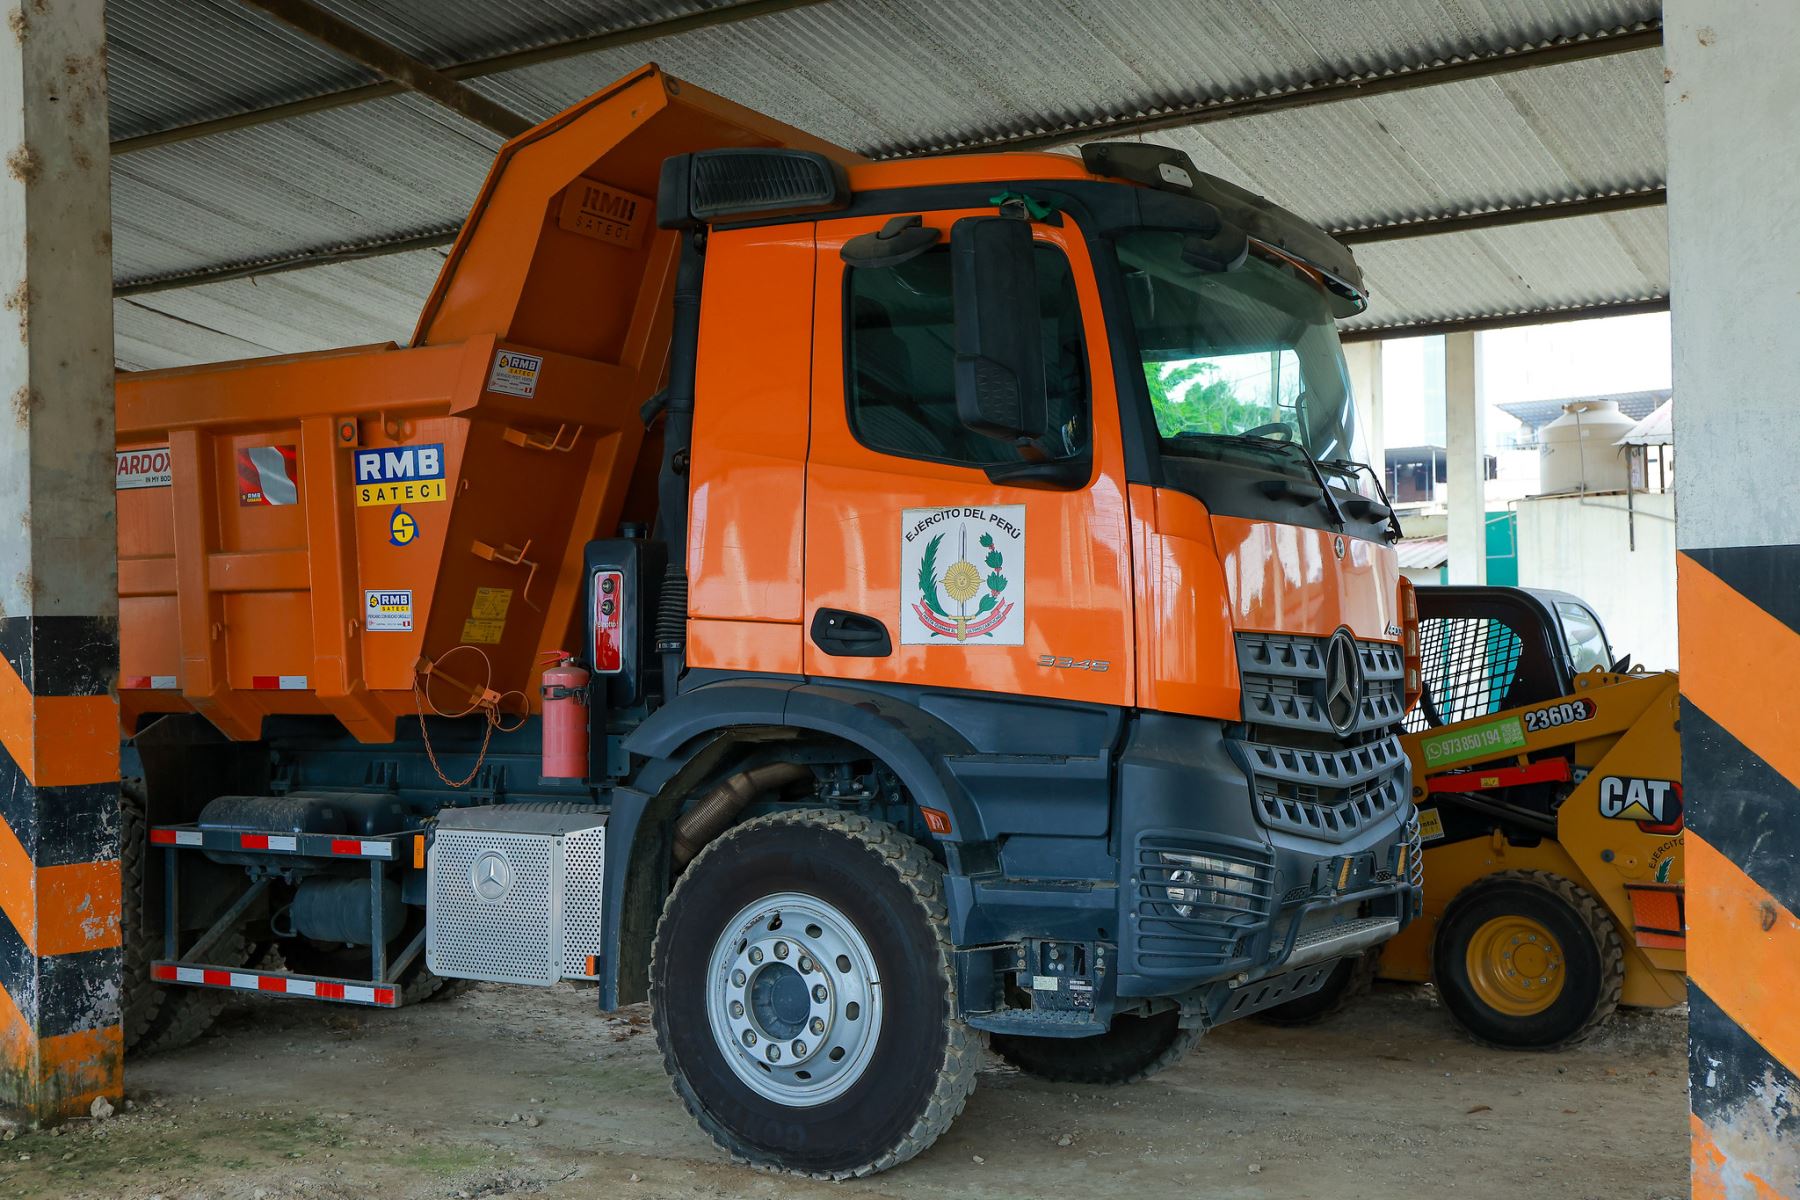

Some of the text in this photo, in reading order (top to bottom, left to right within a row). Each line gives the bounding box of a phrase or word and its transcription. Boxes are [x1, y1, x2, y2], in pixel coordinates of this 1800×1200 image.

[576, 215, 629, 240] SATECI
[511, 358, 536, 370] RMB
[115, 453, 171, 475] ARDOX
[359, 448, 439, 480] RMB
[362, 484, 441, 502] SATECI
[905, 508, 1021, 543] EJÉRCITO DEL PERÚ
[381, 595, 408, 605] RMB
[1037, 655, 1112, 672] 3345
[1525, 700, 1586, 732] 236D3
[1442, 729, 1501, 755] 973 850 194
[1601, 777, 1670, 821] CAT
